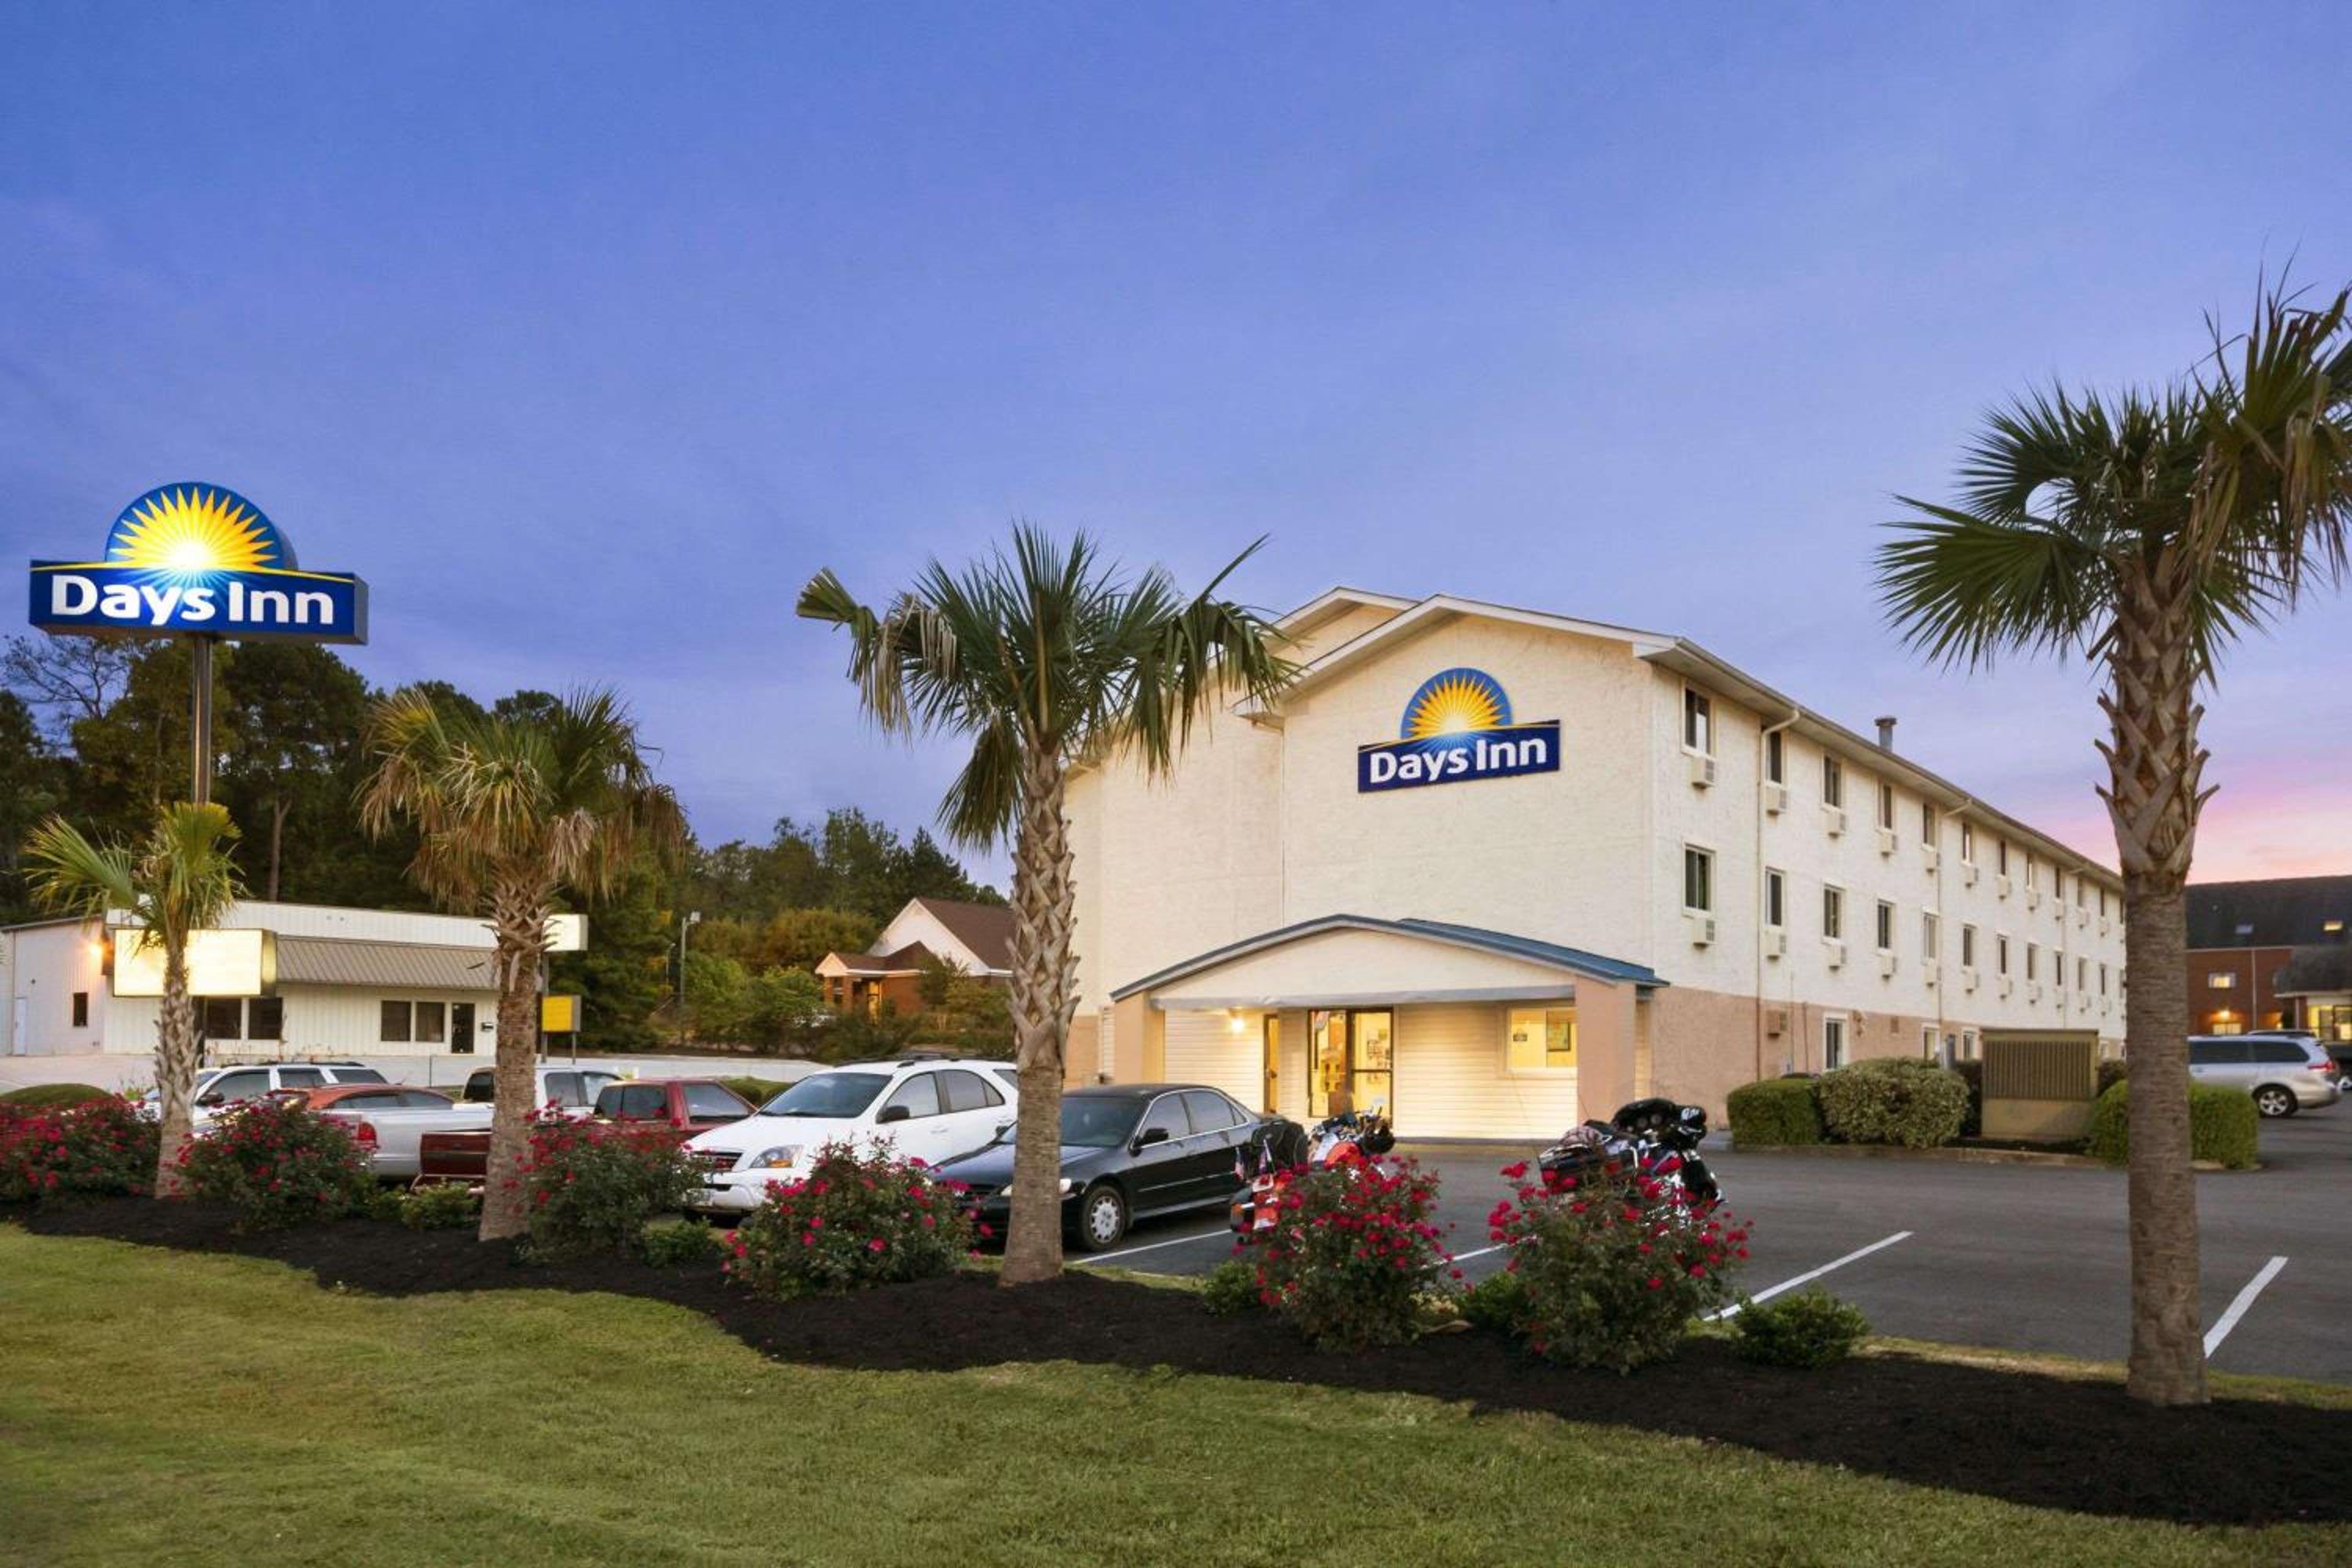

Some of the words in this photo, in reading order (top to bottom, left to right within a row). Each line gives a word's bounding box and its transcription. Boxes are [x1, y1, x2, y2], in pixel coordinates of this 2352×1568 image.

[51, 575, 216, 626] Days
[229, 582, 334, 625] Inn
[1370, 748, 1468, 783] Days
[1476, 738, 1546, 771] Inn
